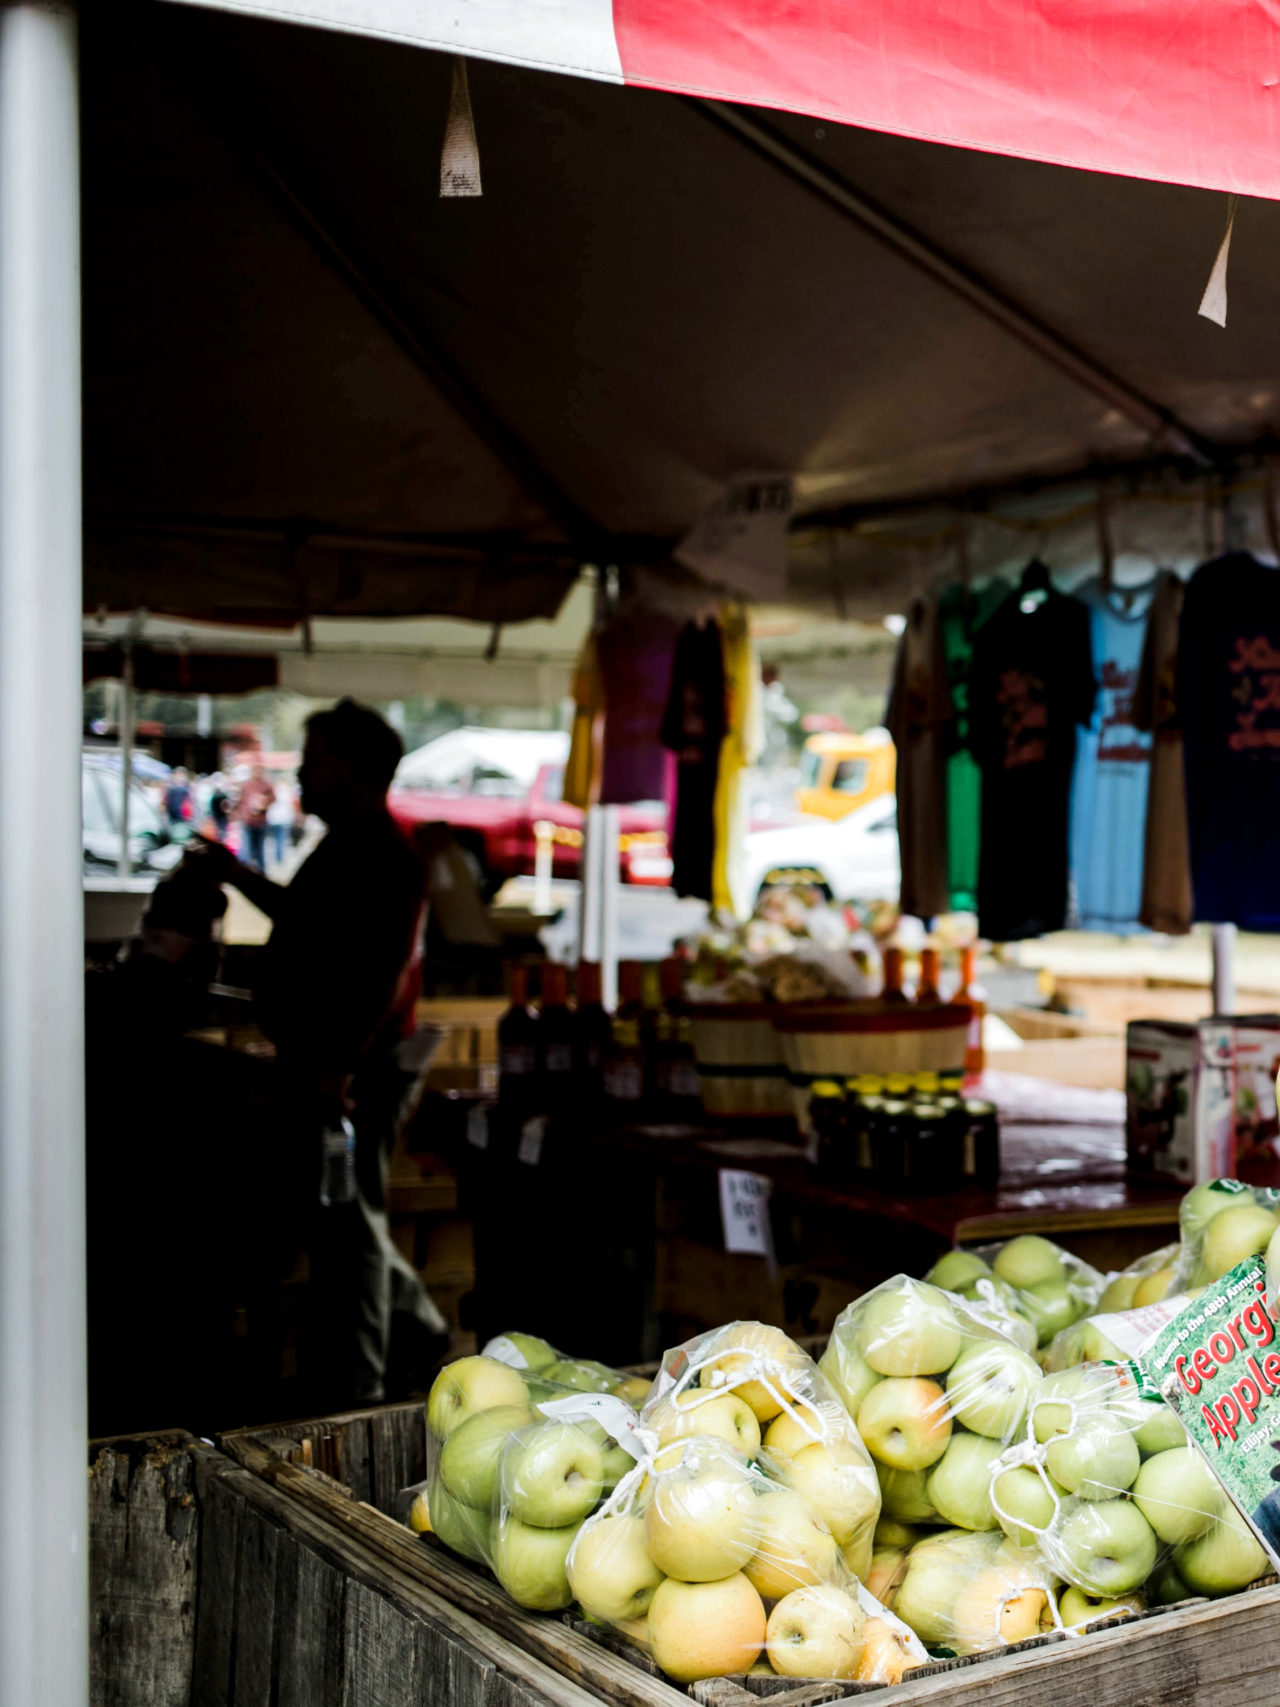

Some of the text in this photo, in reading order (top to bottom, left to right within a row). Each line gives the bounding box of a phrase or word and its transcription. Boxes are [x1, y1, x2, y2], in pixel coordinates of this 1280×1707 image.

[1174, 1282, 1280, 1396] Georgi
[1177, 1329, 1190, 1342] to
[1186, 1313, 1206, 1333] the
[1203, 1295, 1228, 1318] 48th
[1225, 1265, 1264, 1300] Annual
[1241, 1424, 1274, 1454] Ellijay,
